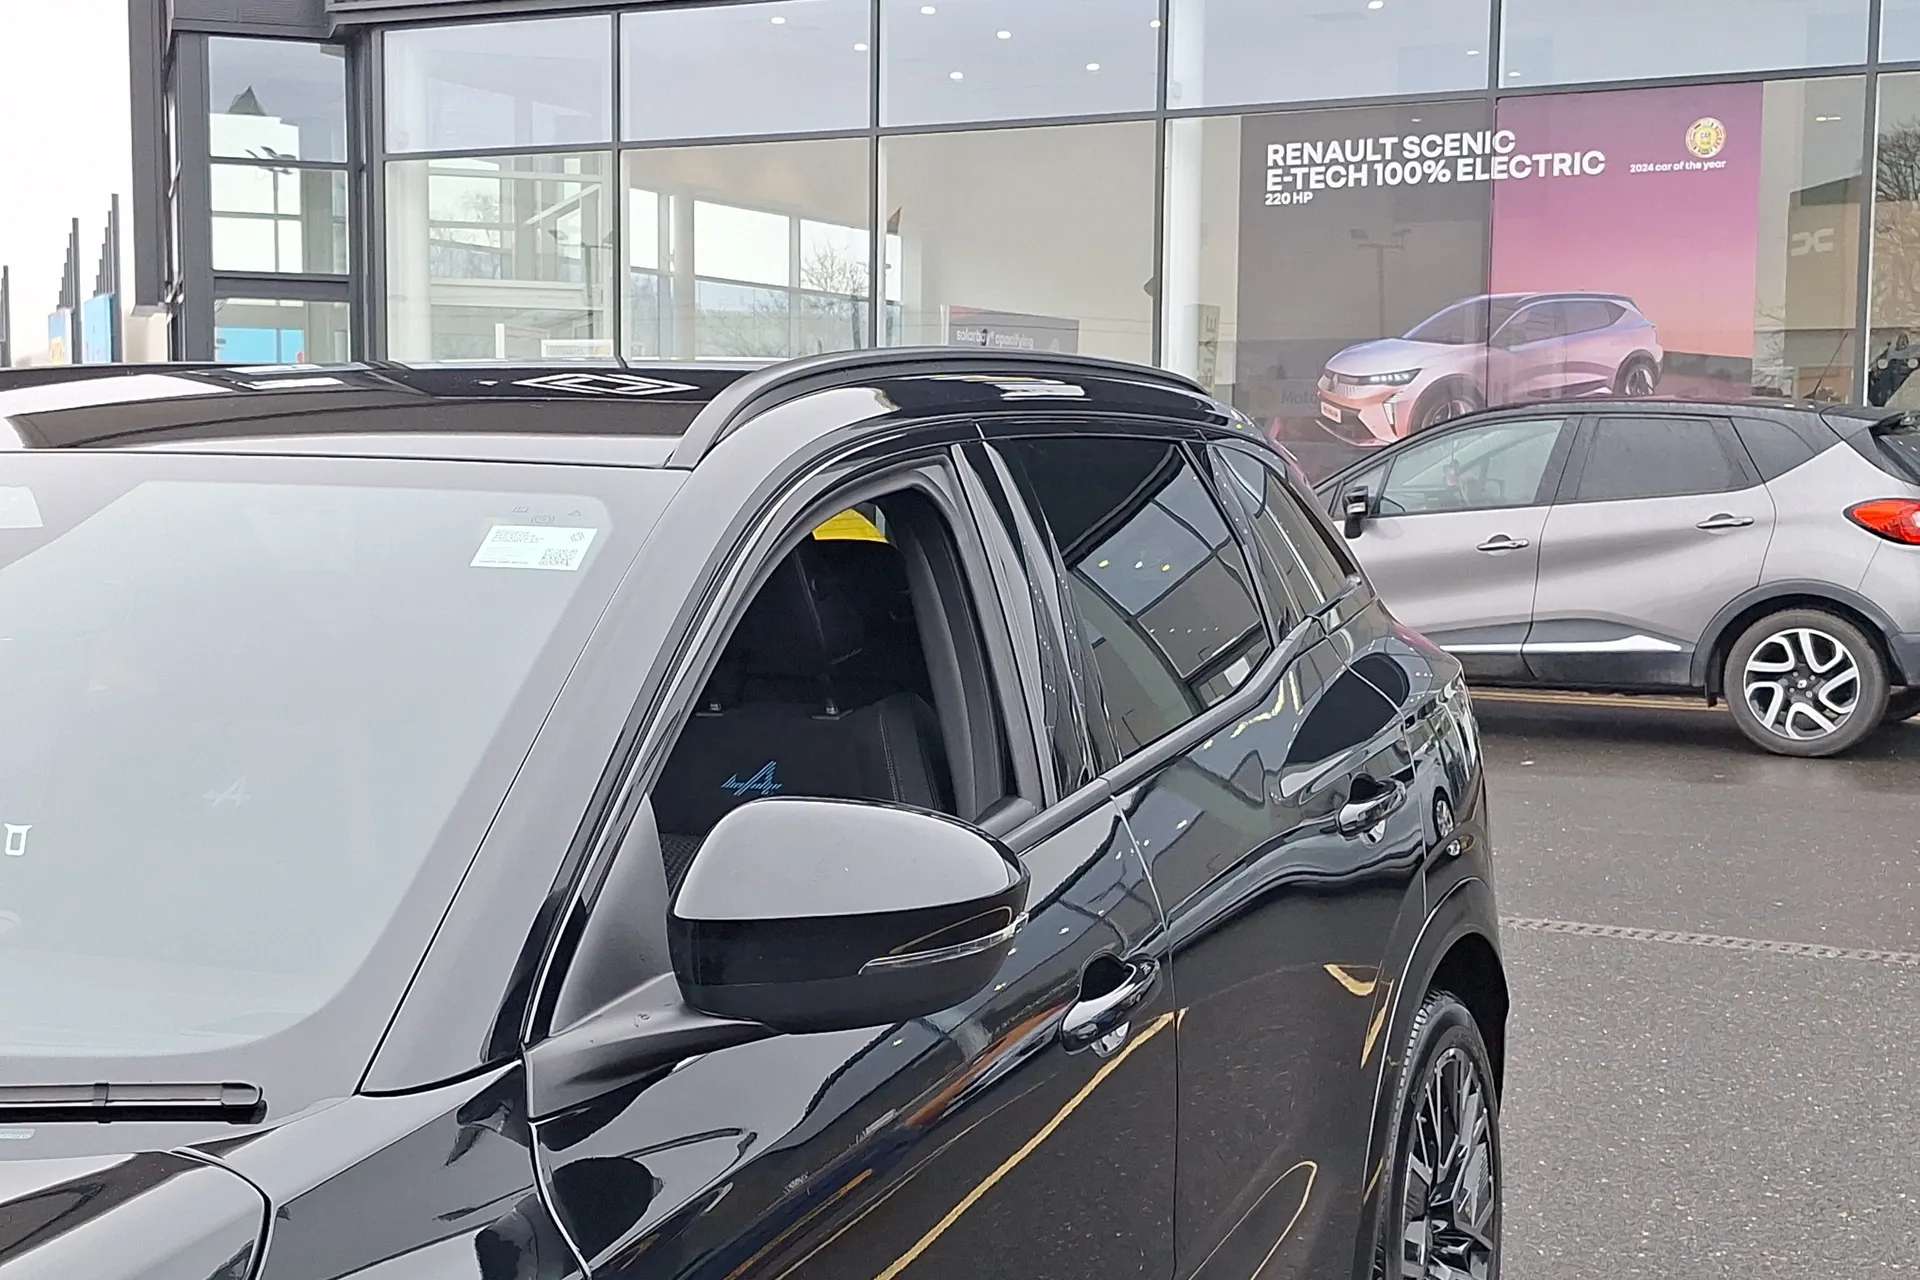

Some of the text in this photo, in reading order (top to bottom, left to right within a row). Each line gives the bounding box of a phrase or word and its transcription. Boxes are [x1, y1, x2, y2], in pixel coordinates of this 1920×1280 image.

[1267, 130, 1516, 166] RENAULT SCENIC
[1266, 150, 1606, 191] E-TECH 100% ELECTRIC
[1629, 160, 1727, 173] 2024 car of the year
[1264, 191, 1313, 206] 220 HP
